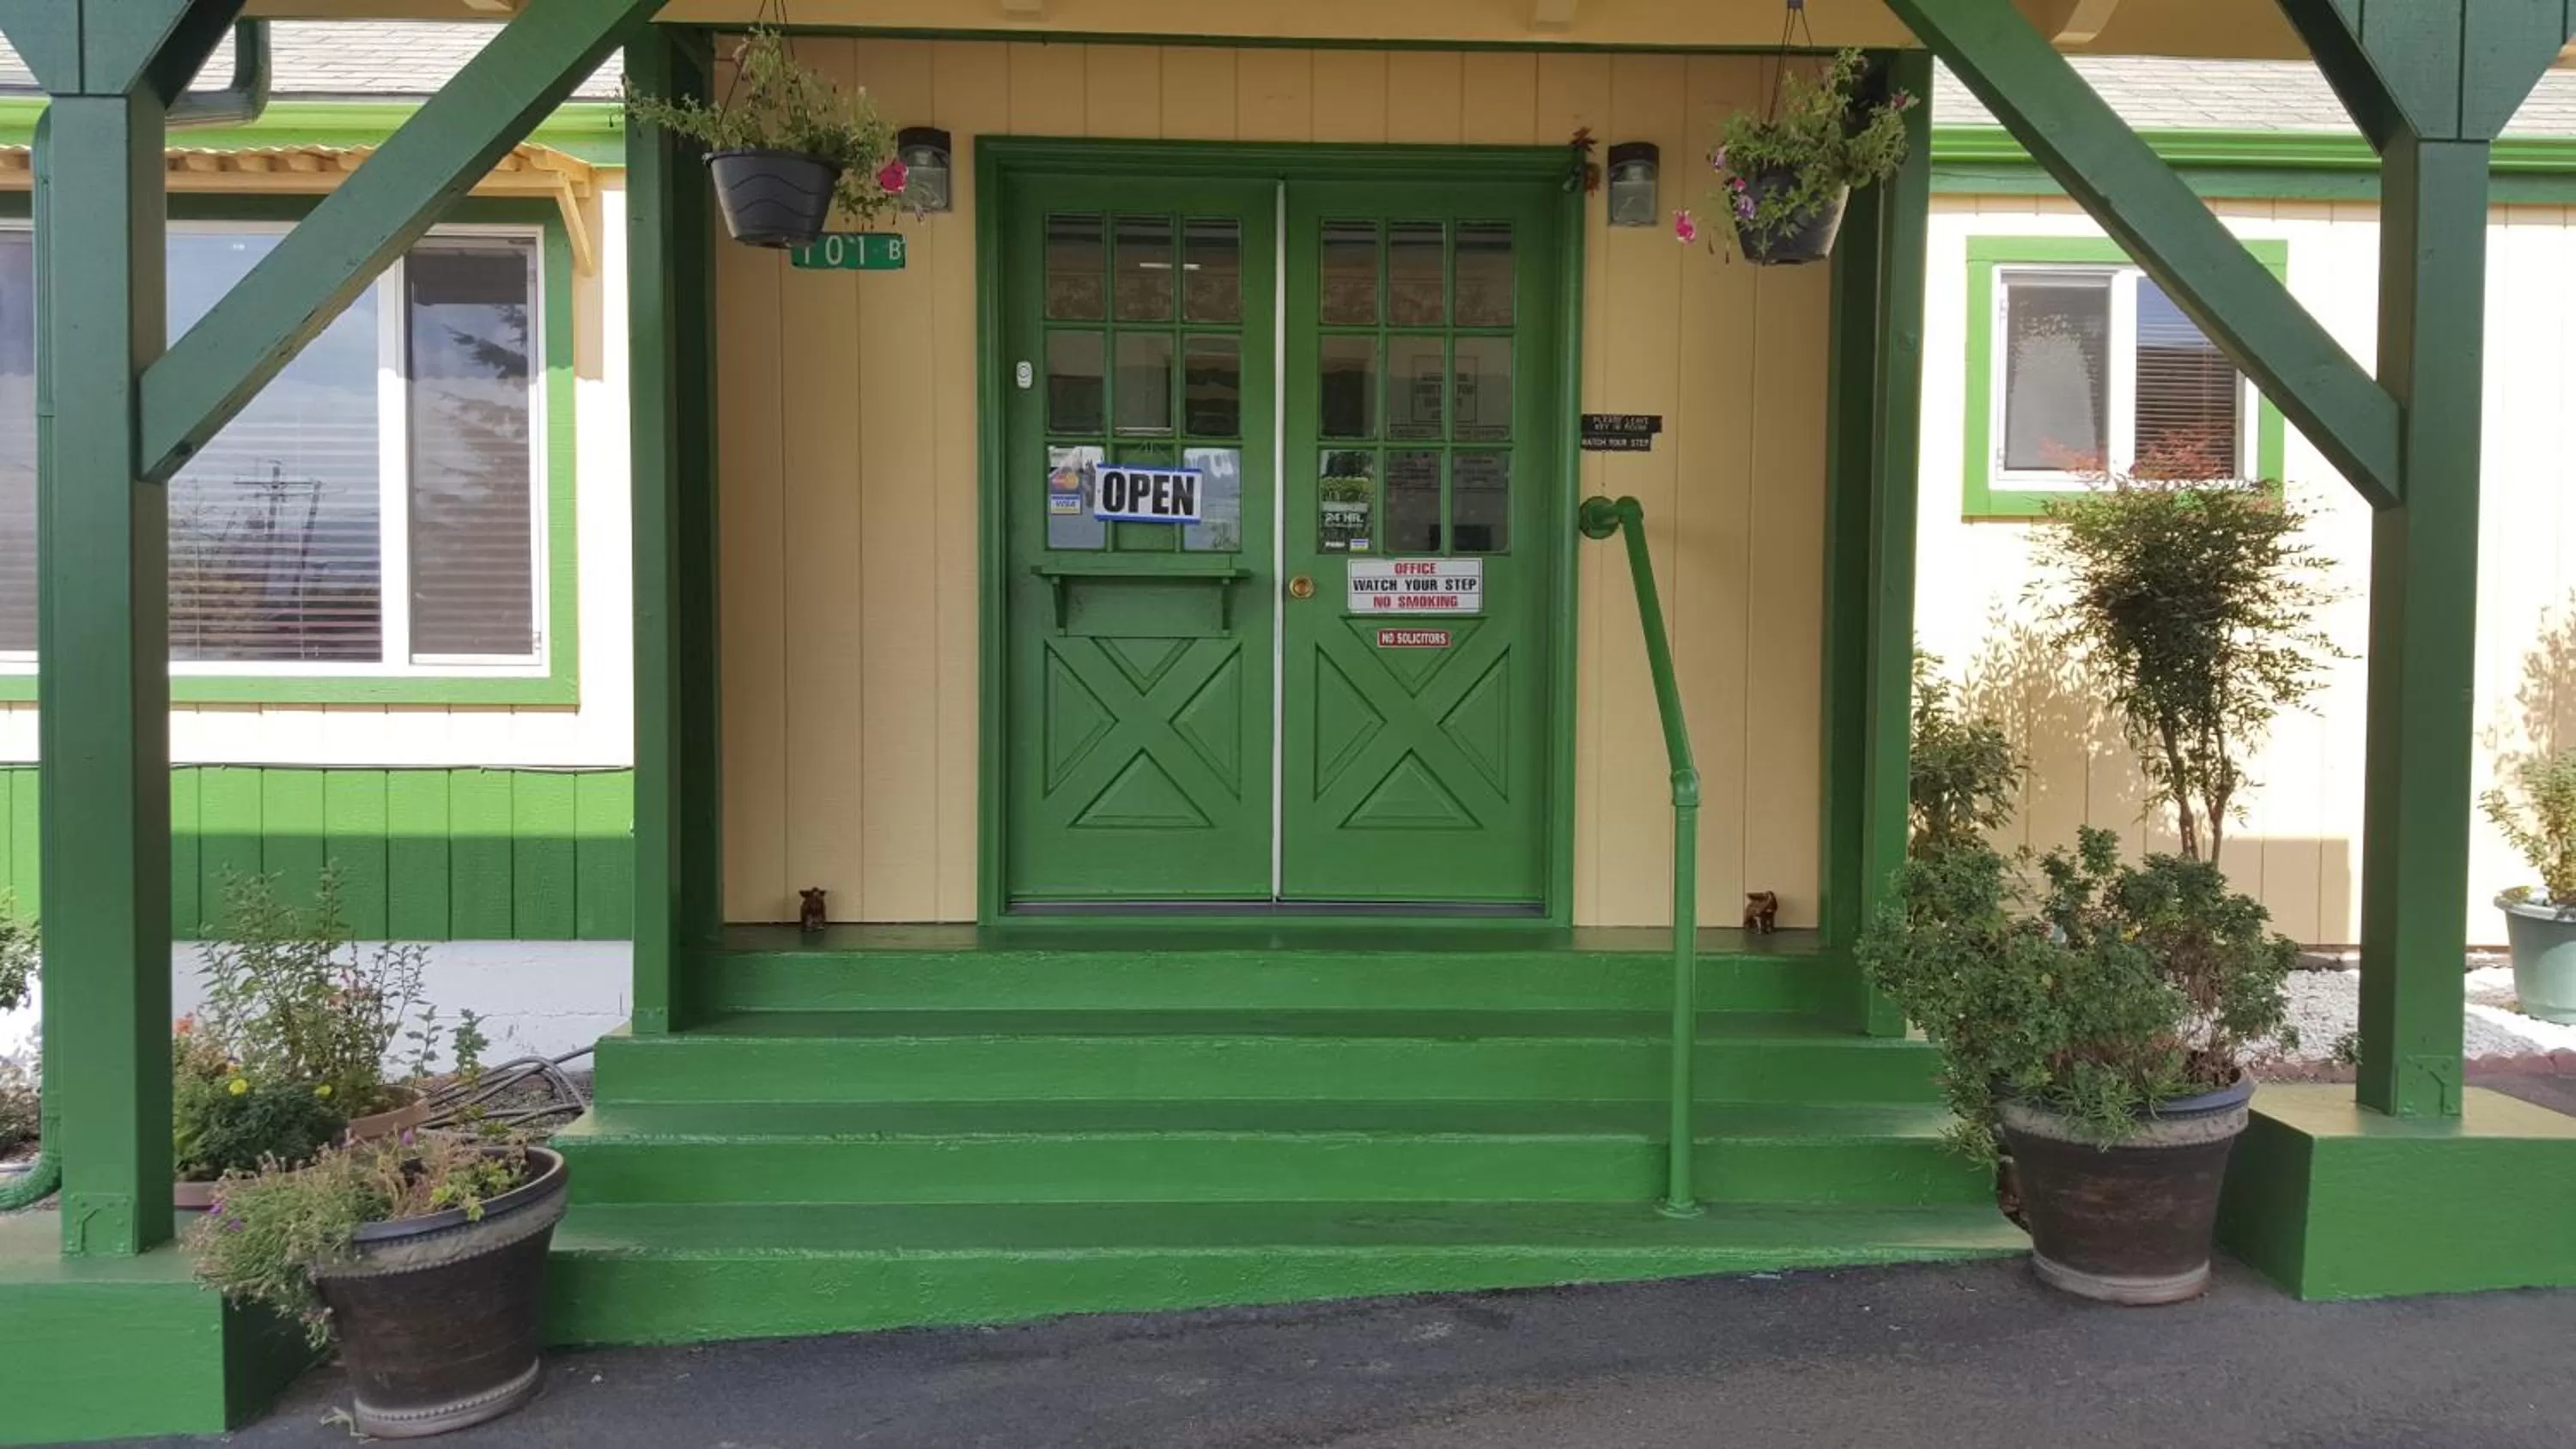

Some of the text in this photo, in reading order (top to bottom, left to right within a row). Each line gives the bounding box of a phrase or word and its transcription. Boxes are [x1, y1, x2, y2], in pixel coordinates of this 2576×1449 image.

[804, 234, 901, 265] 101 B
[1582, 438, 1607, 446] WATCH
[1631, 439, 1649, 447] STEP
[1102, 471, 1195, 516] OPEN
[1394, 562, 1437, 574] OFFICE
[1352, 578, 1477, 591] WATCH YOUR STEP
[1373, 595, 1458, 608] NO SMOKING
[1382, 633, 1447, 644] NO SOLICITORS
